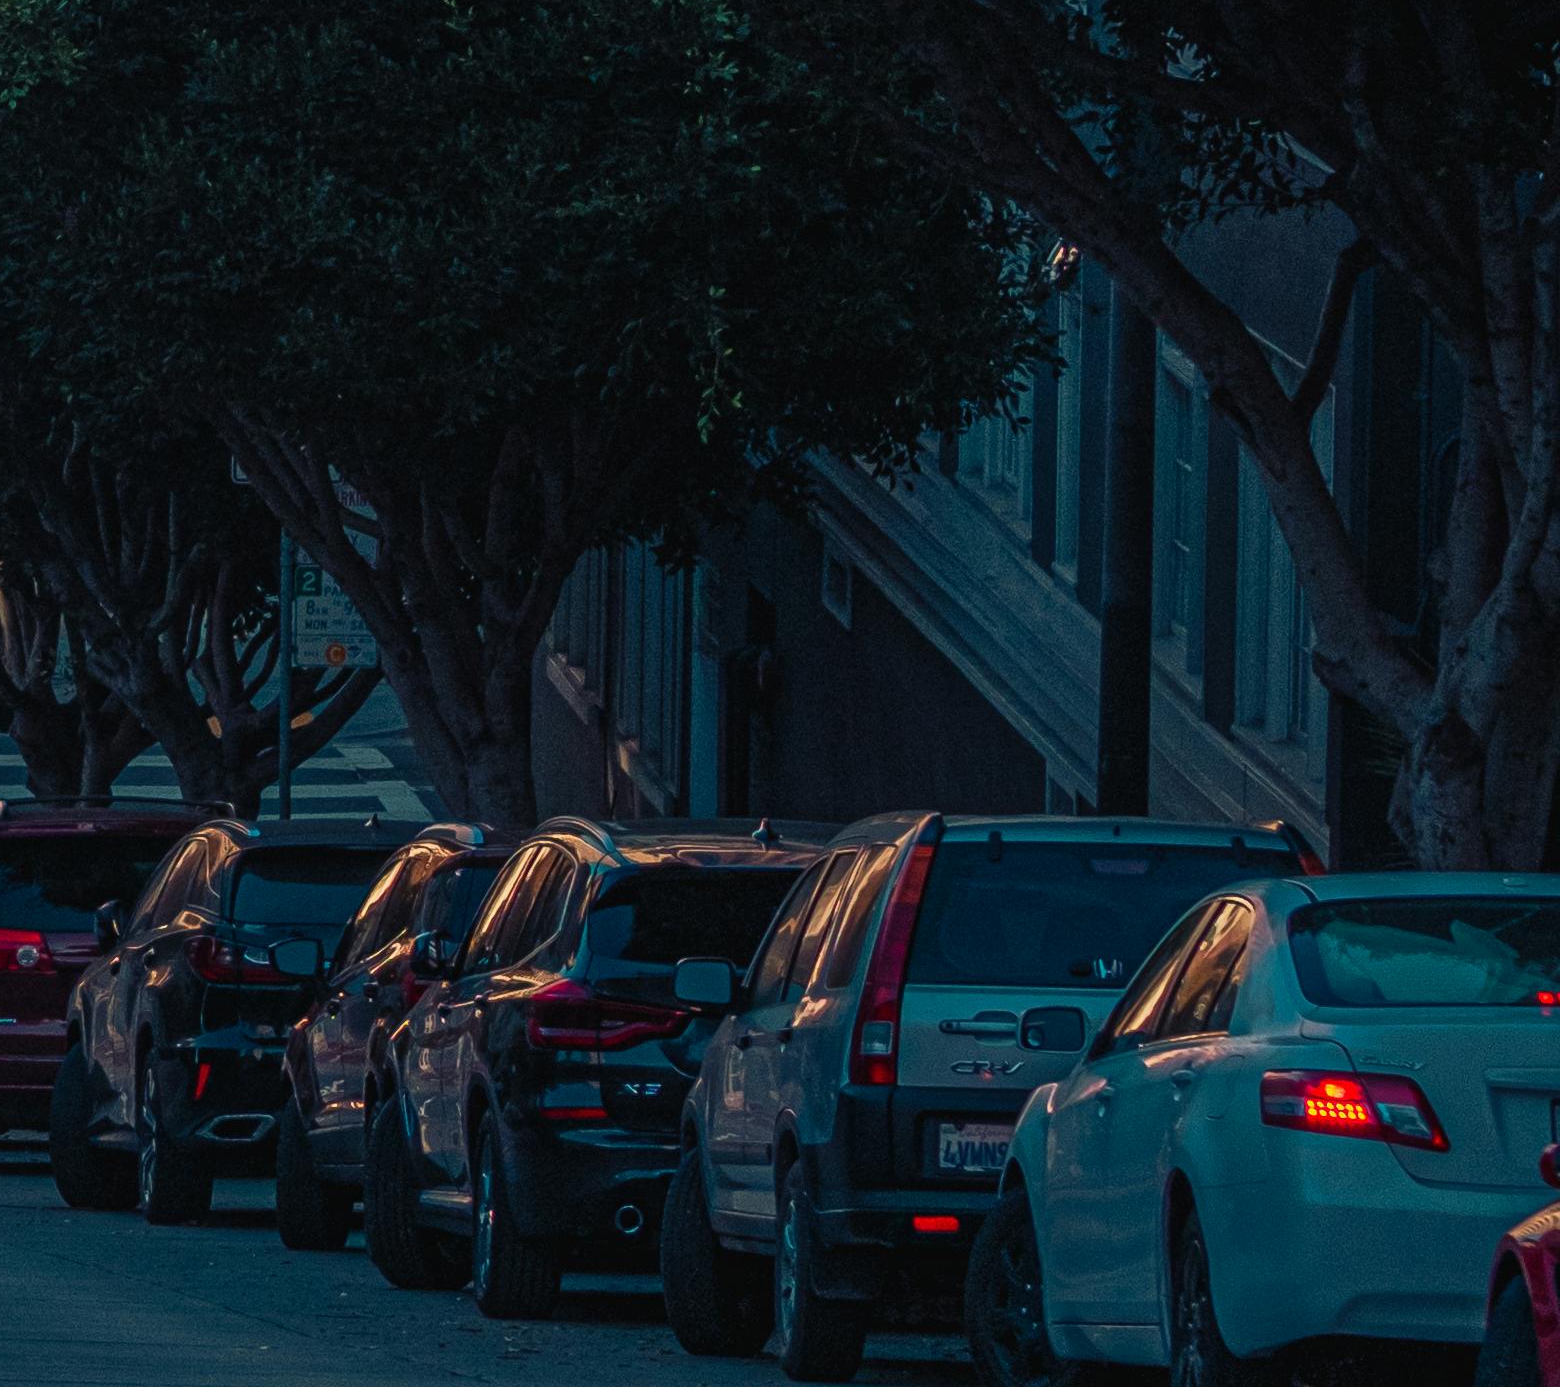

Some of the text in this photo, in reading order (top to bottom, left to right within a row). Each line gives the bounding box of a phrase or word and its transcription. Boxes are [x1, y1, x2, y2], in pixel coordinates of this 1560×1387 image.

[301, 571, 316, 592] 2
[950, 1060, 1025, 1076] CR-V
[943, 1139, 1009, 1167] 4VWN9
